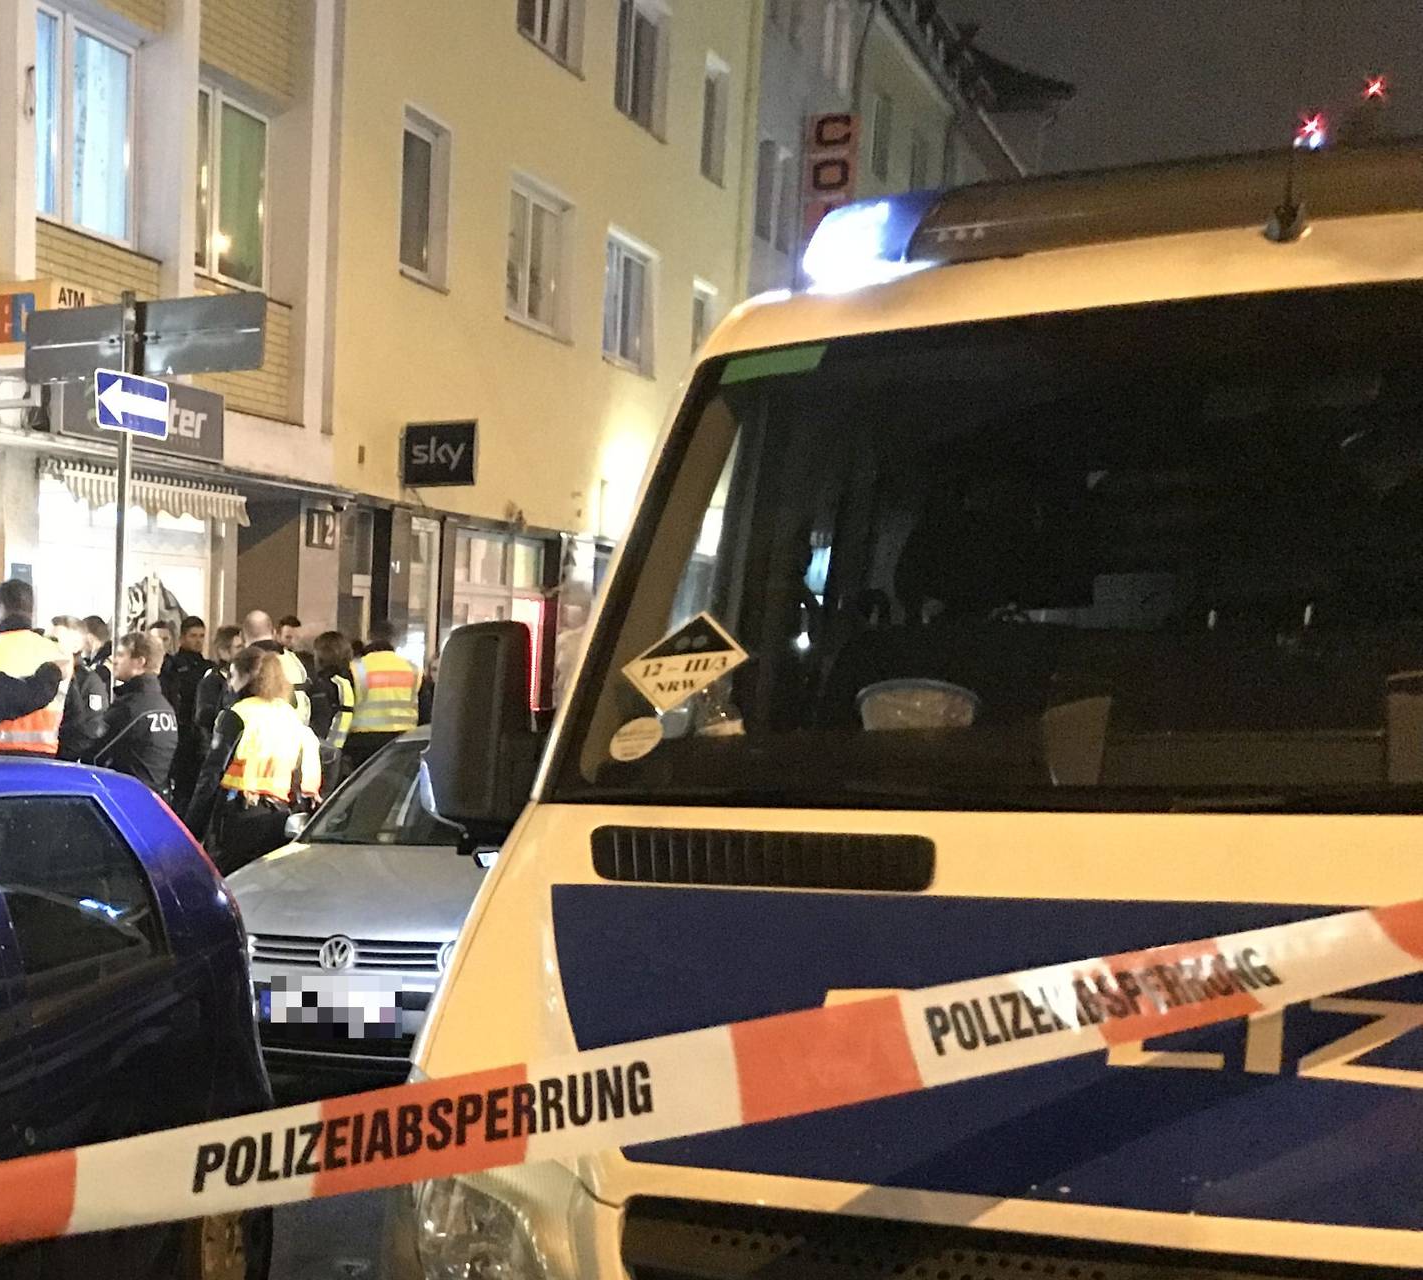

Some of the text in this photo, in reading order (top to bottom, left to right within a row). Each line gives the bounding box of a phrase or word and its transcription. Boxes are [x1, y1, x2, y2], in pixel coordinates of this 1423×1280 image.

[813, 114, 852, 190] CO
[58, 286, 85, 309] ATM
[169, 399, 208, 439] ter
[411, 436, 466, 471] sky
[311, 512, 336, 546] 12
[642, 662, 664, 679] 12
[654, 678, 700, 694] NRW
[925, 948, 1281, 1056] POLIZEIBSPERRUNG
[191, 1060, 654, 1194] POLIZEIABSPERRUNG
